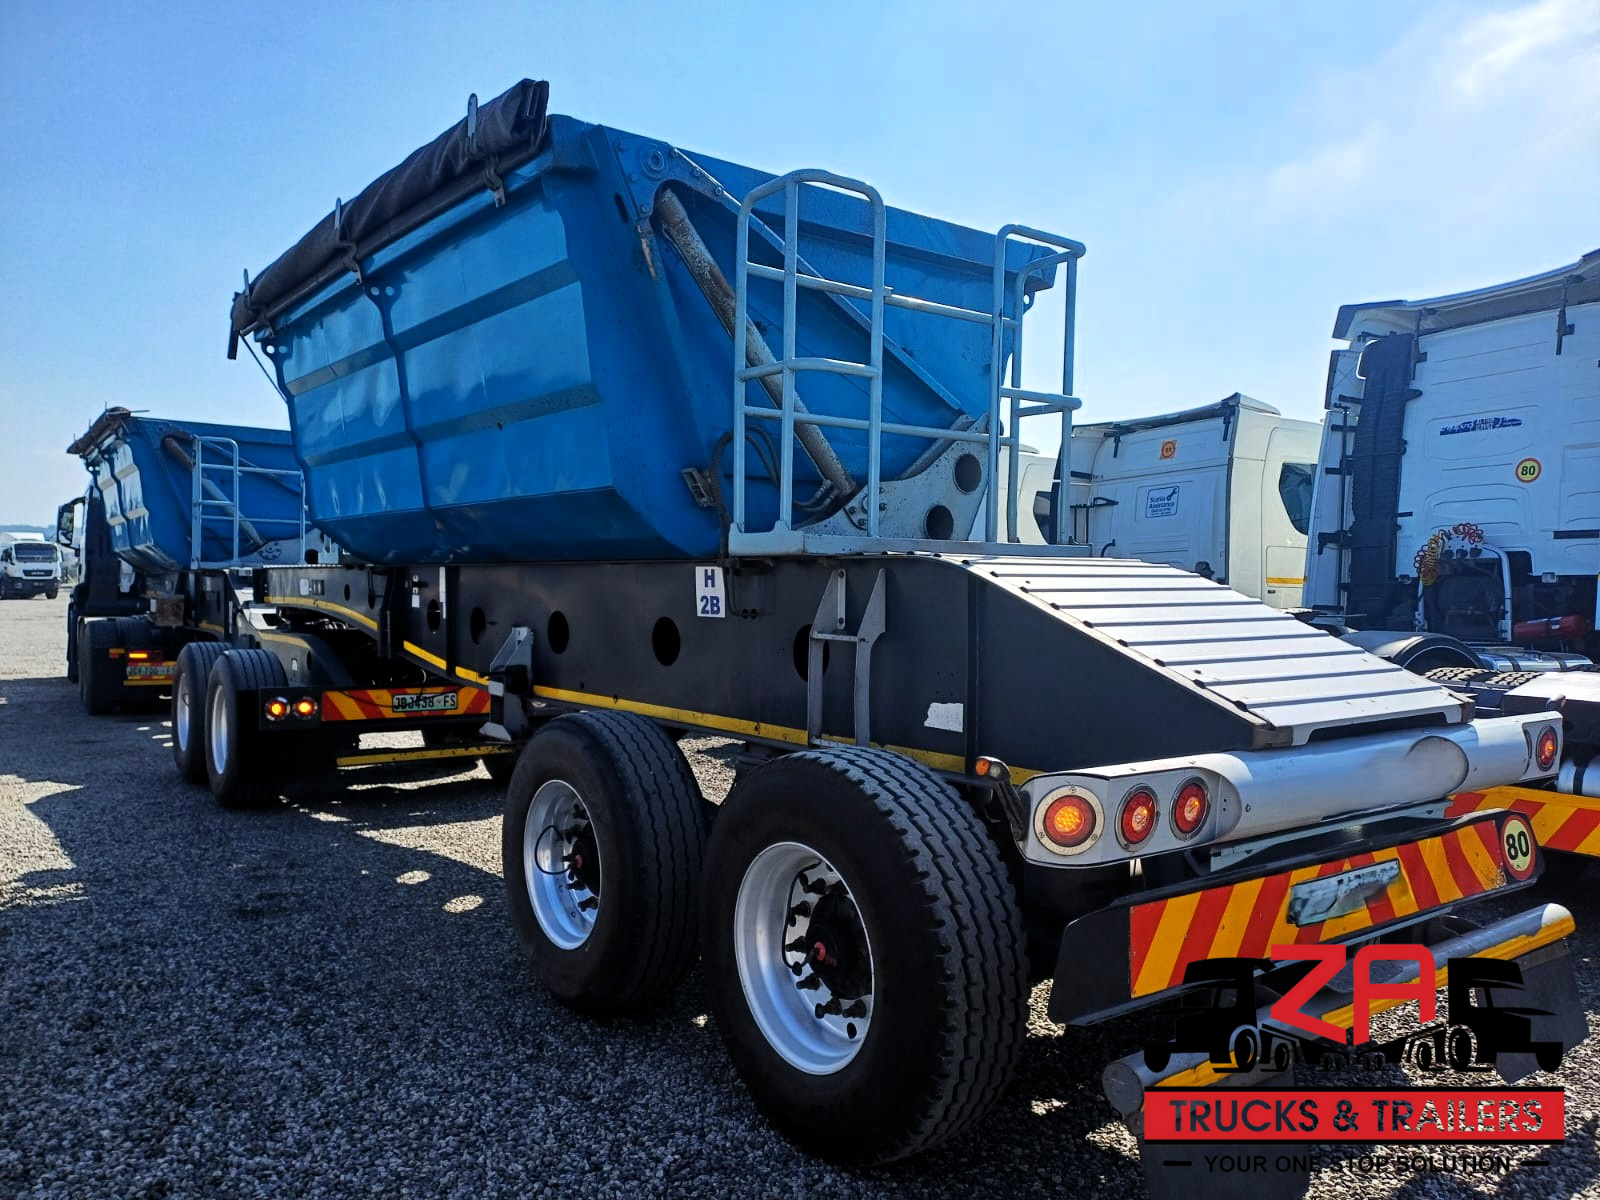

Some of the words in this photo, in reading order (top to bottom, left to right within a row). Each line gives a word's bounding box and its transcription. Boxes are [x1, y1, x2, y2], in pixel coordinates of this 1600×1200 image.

[1521, 465, 1536, 476] 80
[704, 568, 716, 588] H
[700, 595, 721, 615] 2B
[443, 694, 456, 707] FS
[1505, 830, 1530, 861] 80
